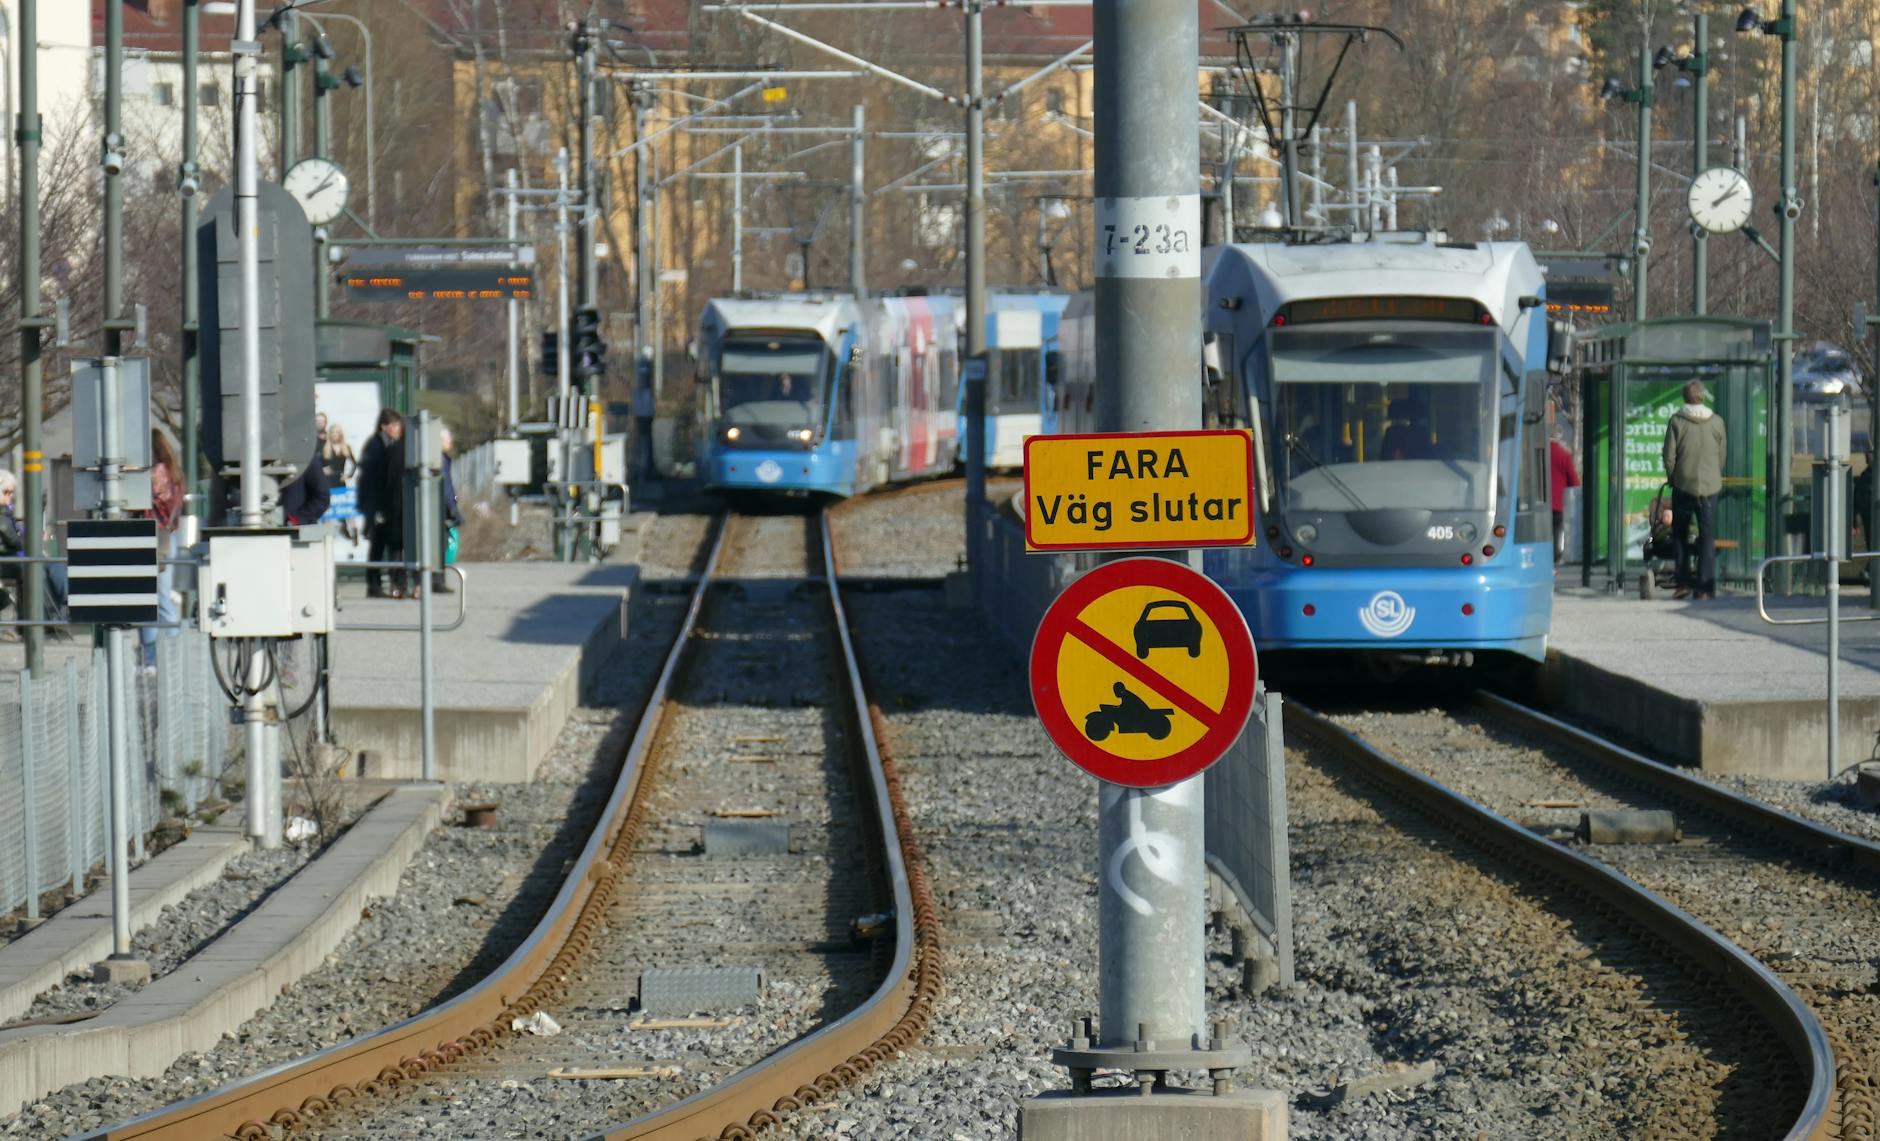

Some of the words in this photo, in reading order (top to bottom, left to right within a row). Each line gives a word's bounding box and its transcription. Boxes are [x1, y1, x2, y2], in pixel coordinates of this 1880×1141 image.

[1104, 224, 1189, 255] 7-23a
[1087, 448, 1189, 480] FARA
[1036, 494, 1112, 531] Väg
[1130, 492, 1241, 523] slutar
[1427, 526, 1454, 540] 405
